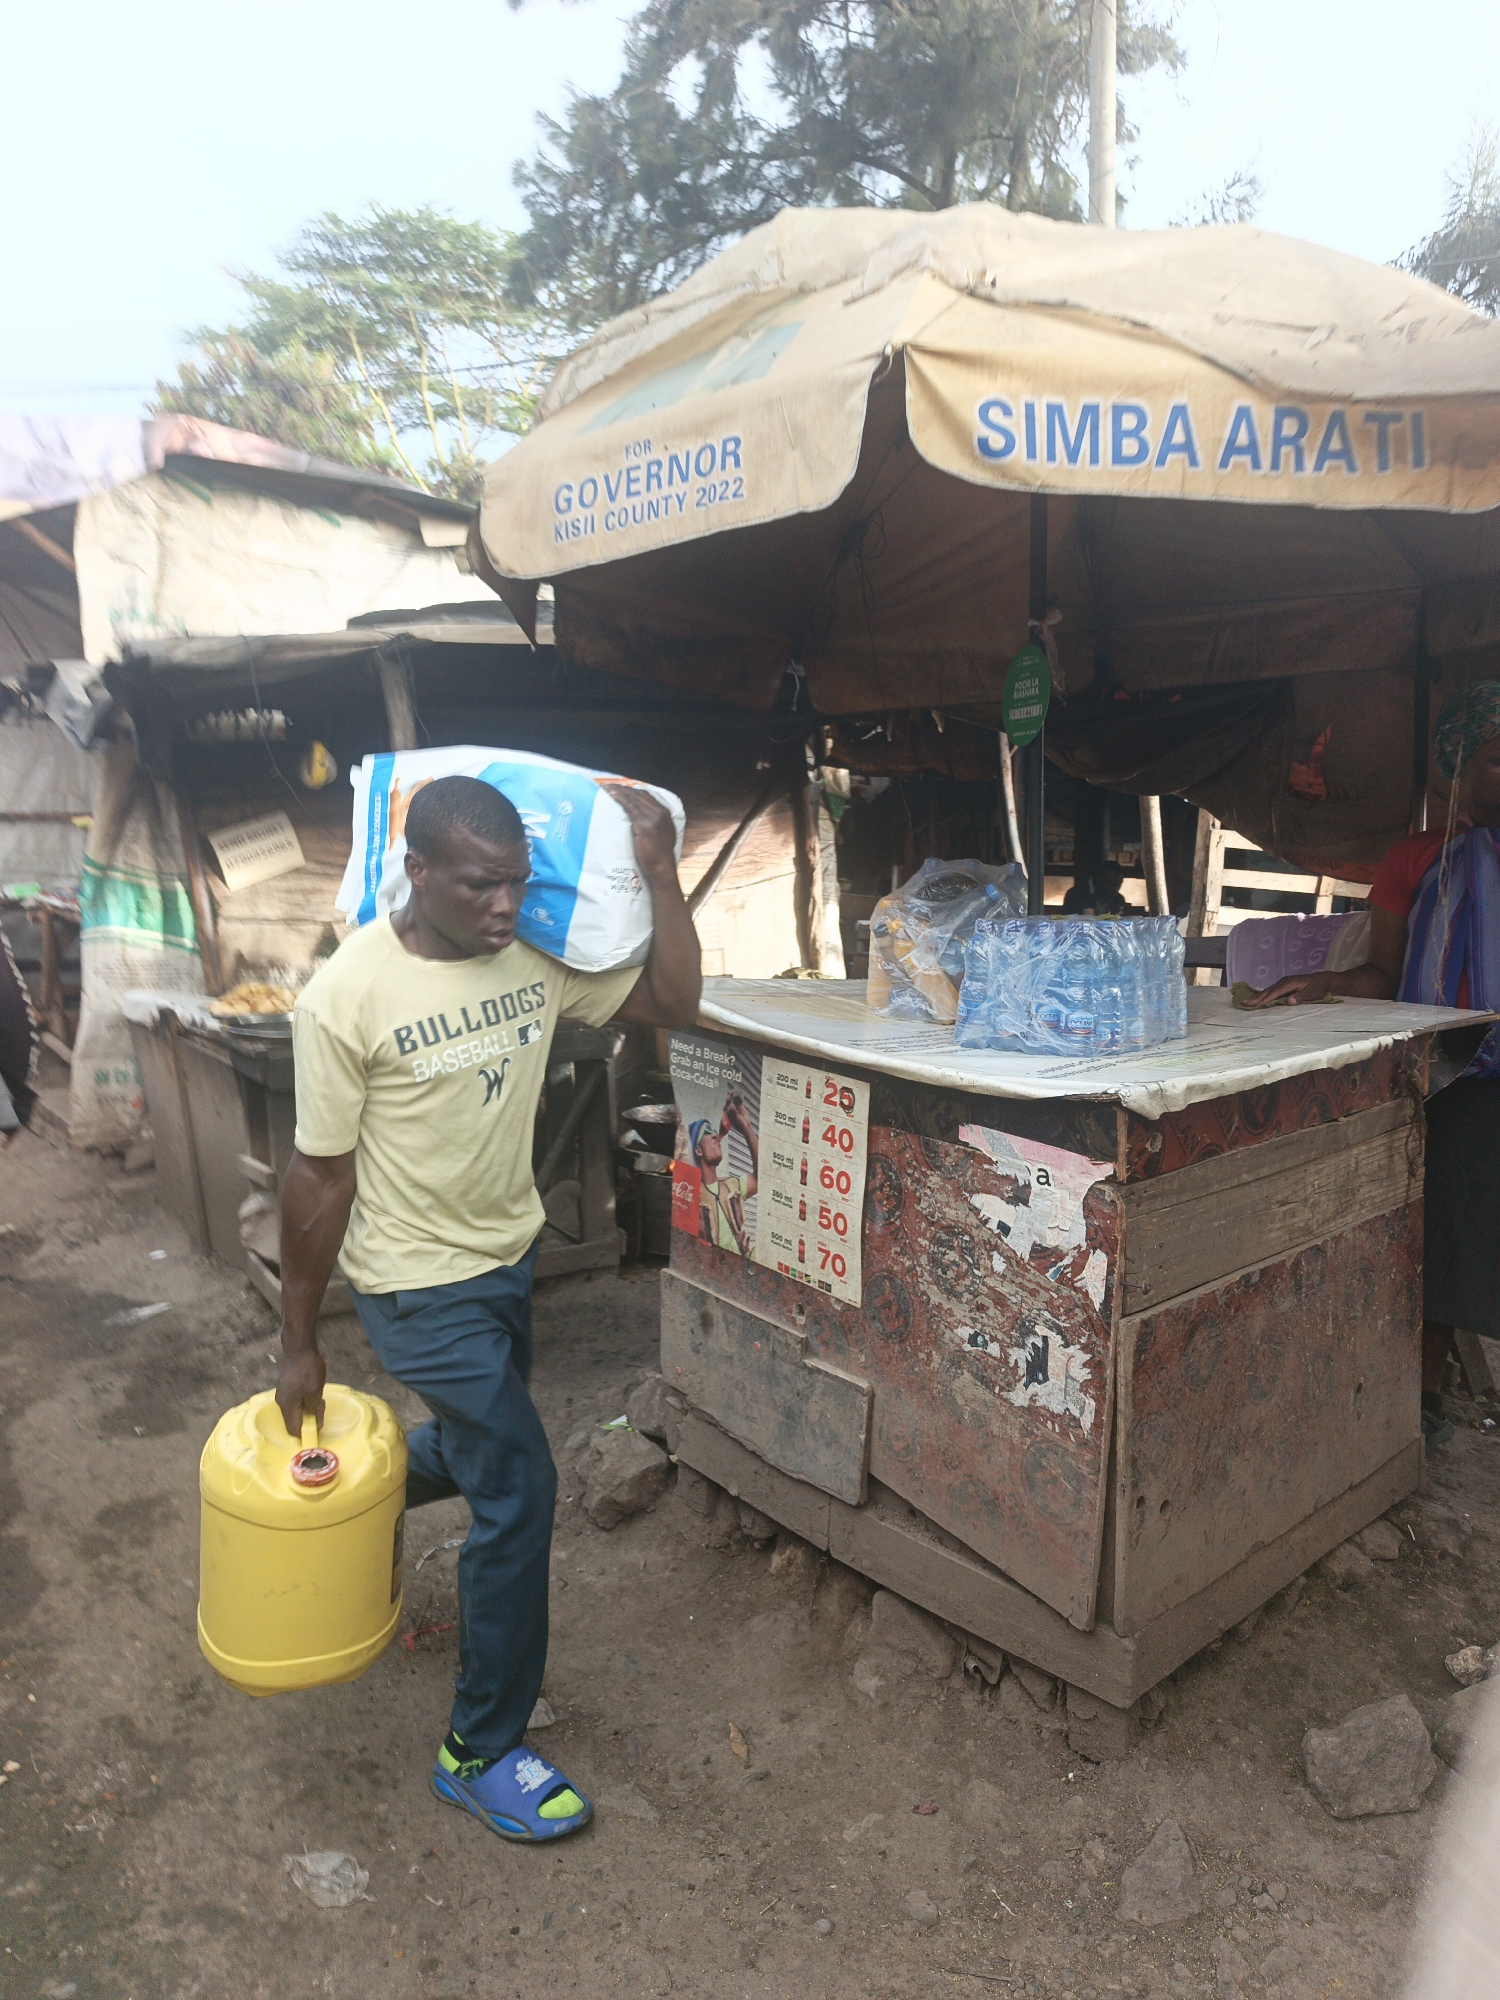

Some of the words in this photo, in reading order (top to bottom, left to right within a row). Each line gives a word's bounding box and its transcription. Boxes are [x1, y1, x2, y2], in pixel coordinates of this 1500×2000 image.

[623, 437, 653, 462] FOR
[975, 397, 1200, 471] SIMBA
[1216, 404, 1430, 475] ARATI
[553, 433, 743, 517] GOVERNOR
[552, 512, 597, 544] KISII
[603, 489, 688, 532] COUNTY
[694, 475, 746, 510] 2022
[1031, 676, 1039, 687] LA
[392, 981, 546, 1057] BULLDOGS
[412, 1030, 517, 1083] BASEBALL
[670, 1038, 695, 1055] Need
[695, 1048, 702, 1057] a
[703, 1047, 736, 1066] Break?
[478, 1055, 513, 1107] W
[670, 1052, 691, 1067] Grab
[692, 1060, 705, 1071] an
[721, 1069, 742, 1083] cold
[776, 1073, 789, 1083] 200
[789, 1077, 798, 1086] ml
[774, 1110, 787, 1121] 300
[787, 1114, 796, 1124] ml
[821, 1124, 854, 1153] 40
[772, 1151, 785, 1161] 500
[785, 1156, 794, 1165] ml
[819, 1165, 851, 1195] 60
[771, 1189, 784, 1200] 350
[784, 1195, 793, 1203] ml
[817, 1205, 848, 1236] 50
[770, 1231, 783, 1242] 500
[783, 1237, 792, 1246] ml
[817, 1246, 846, 1278] 70
